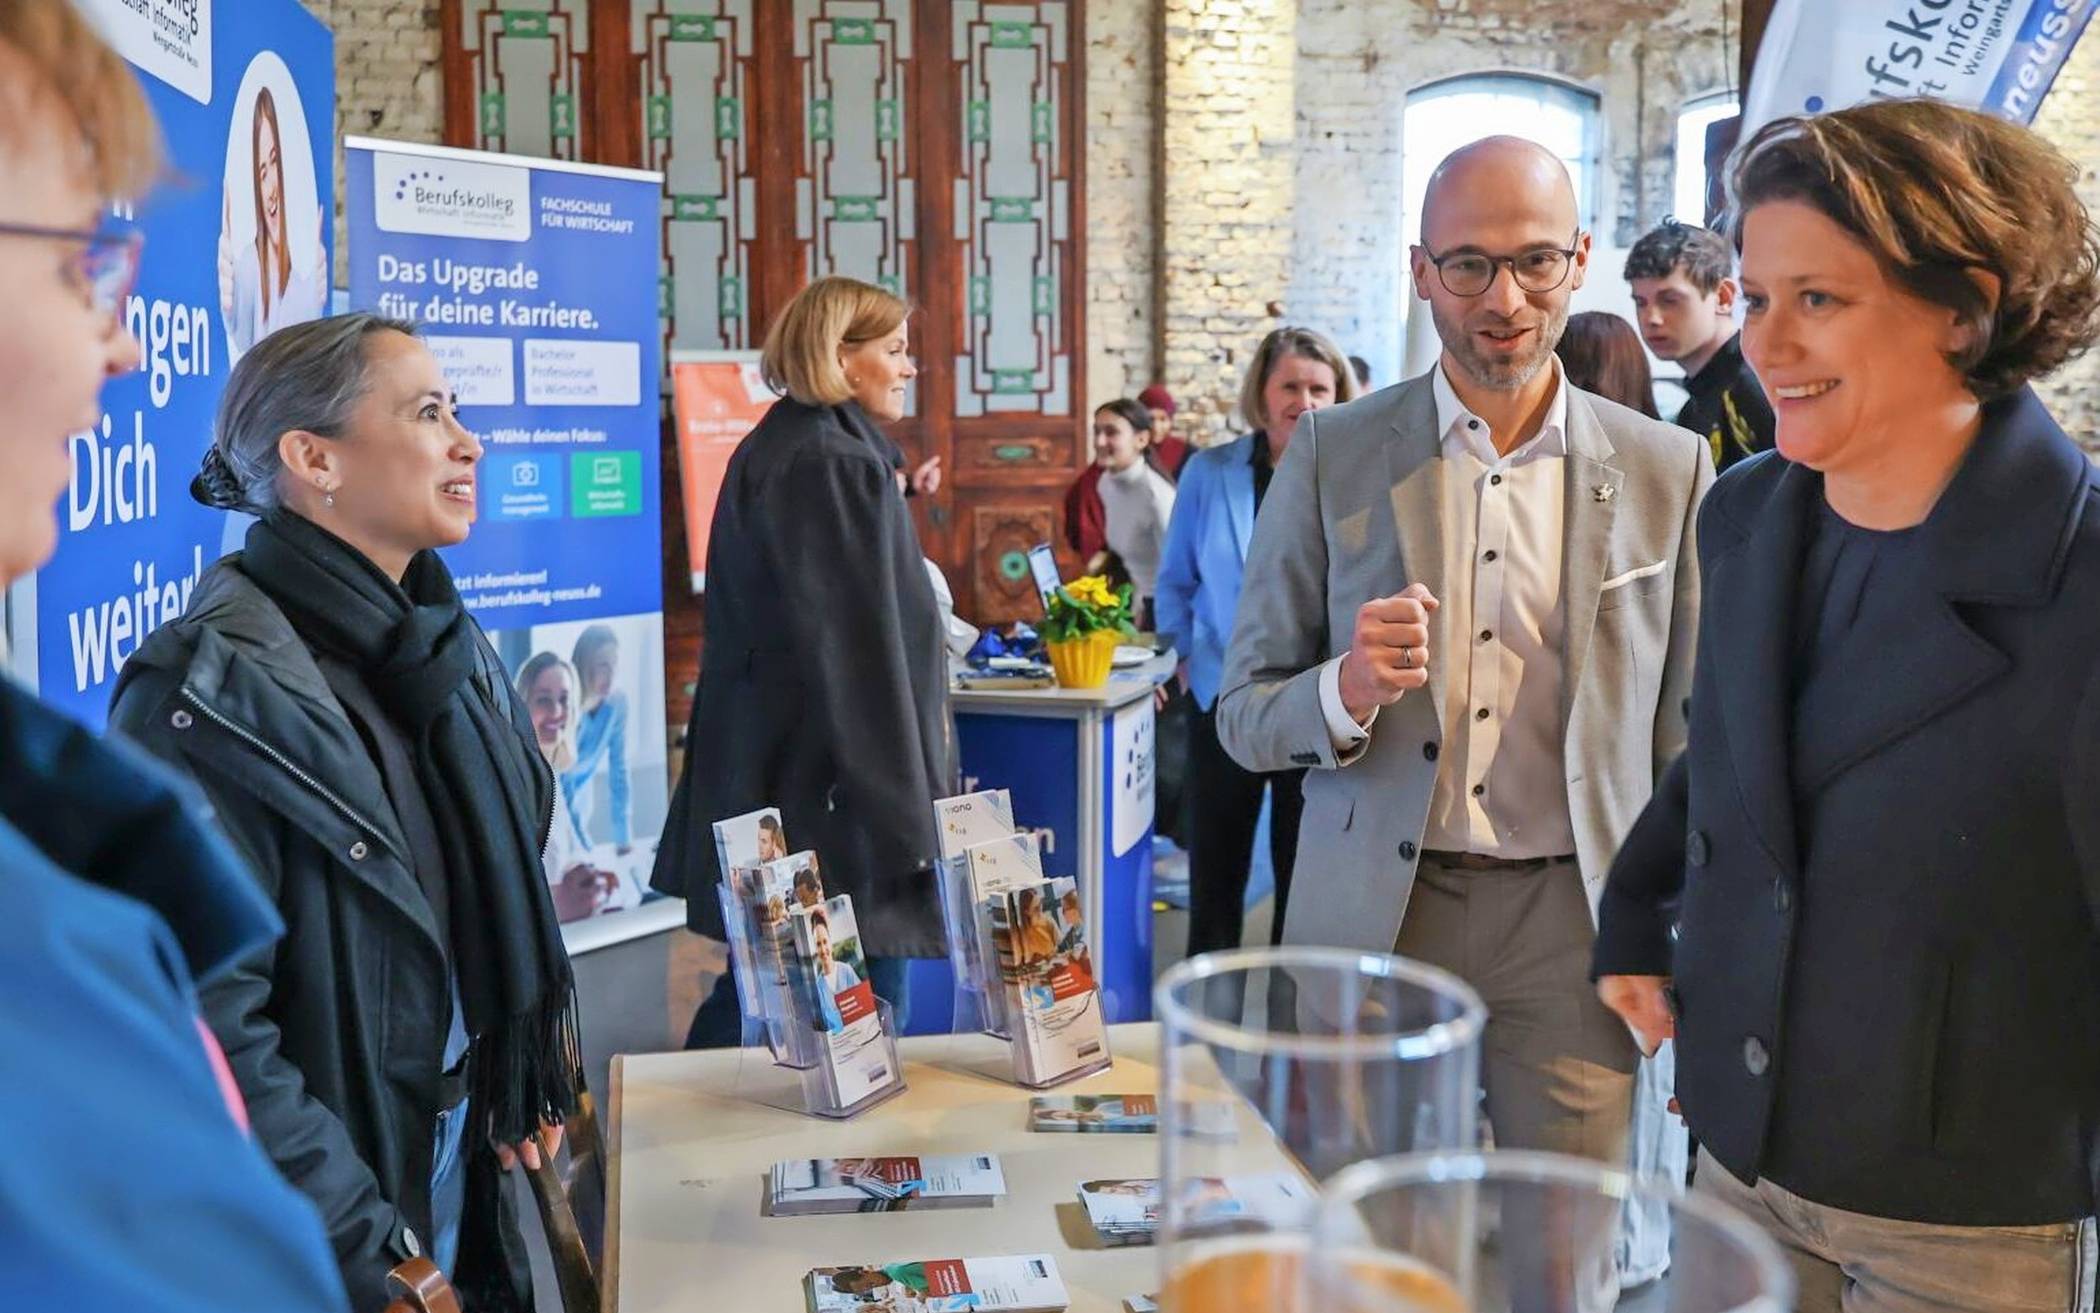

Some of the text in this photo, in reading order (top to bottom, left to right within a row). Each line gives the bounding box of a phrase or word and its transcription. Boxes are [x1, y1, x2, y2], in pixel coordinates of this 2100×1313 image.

[415, 186, 514, 216] Berufskolleg
[541, 197, 612, 216] FACHSCHULE
[541, 213, 635, 234] FÜR WIRTSCHAFT
[378, 254, 539, 294] Das Upgrade
[378, 292, 599, 329] für deine Karriere.
[491, 427, 531, 444] Wähle
[533, 429, 569, 443] deinen
[68, 410, 157, 531] Dich
